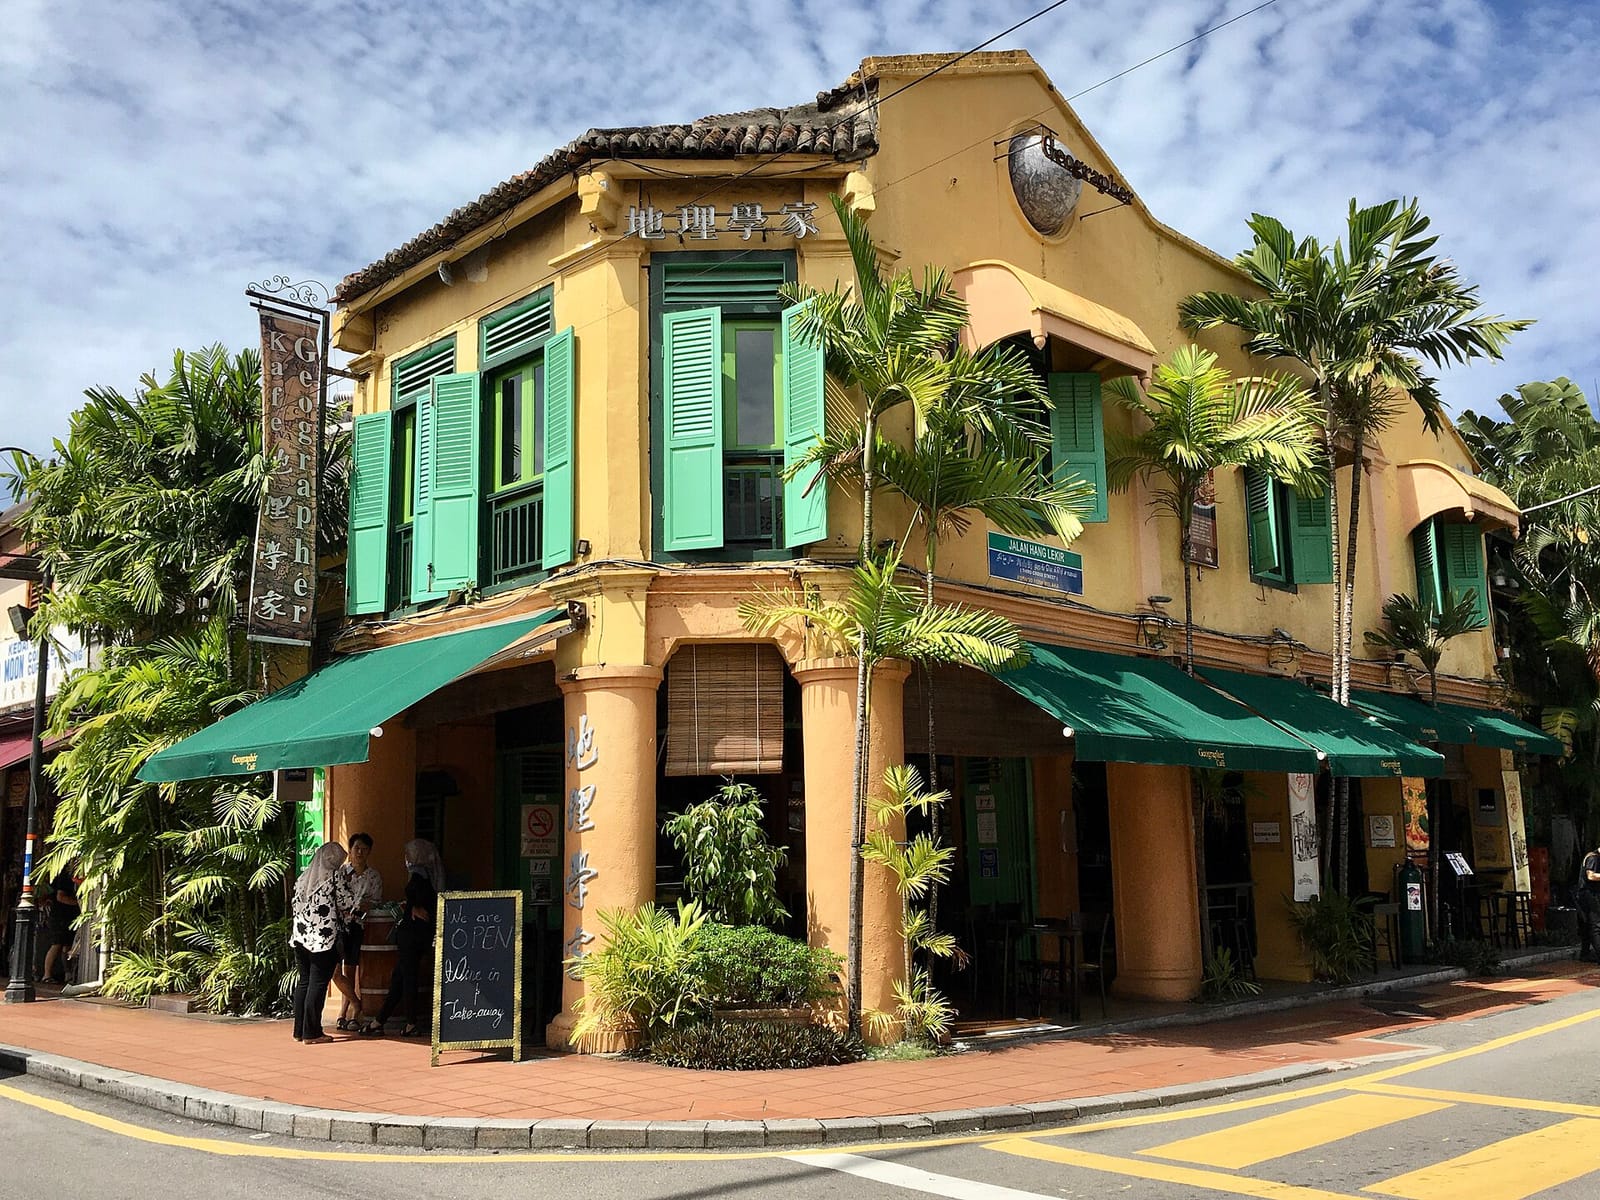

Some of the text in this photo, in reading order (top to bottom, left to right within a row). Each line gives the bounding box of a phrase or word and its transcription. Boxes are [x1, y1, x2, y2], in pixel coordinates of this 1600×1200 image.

[624, 201, 820, 241] 地理學家
[269, 330, 288, 432] Kafe
[1008, 539, 1029, 554] JALAN
[1030, 544, 1047, 559] HANG
[1047, 548, 1065, 563] LEKIR
[476, 913, 502, 923] are
[451, 925, 514, 950] OPEN
[488, 967, 501, 981] in
